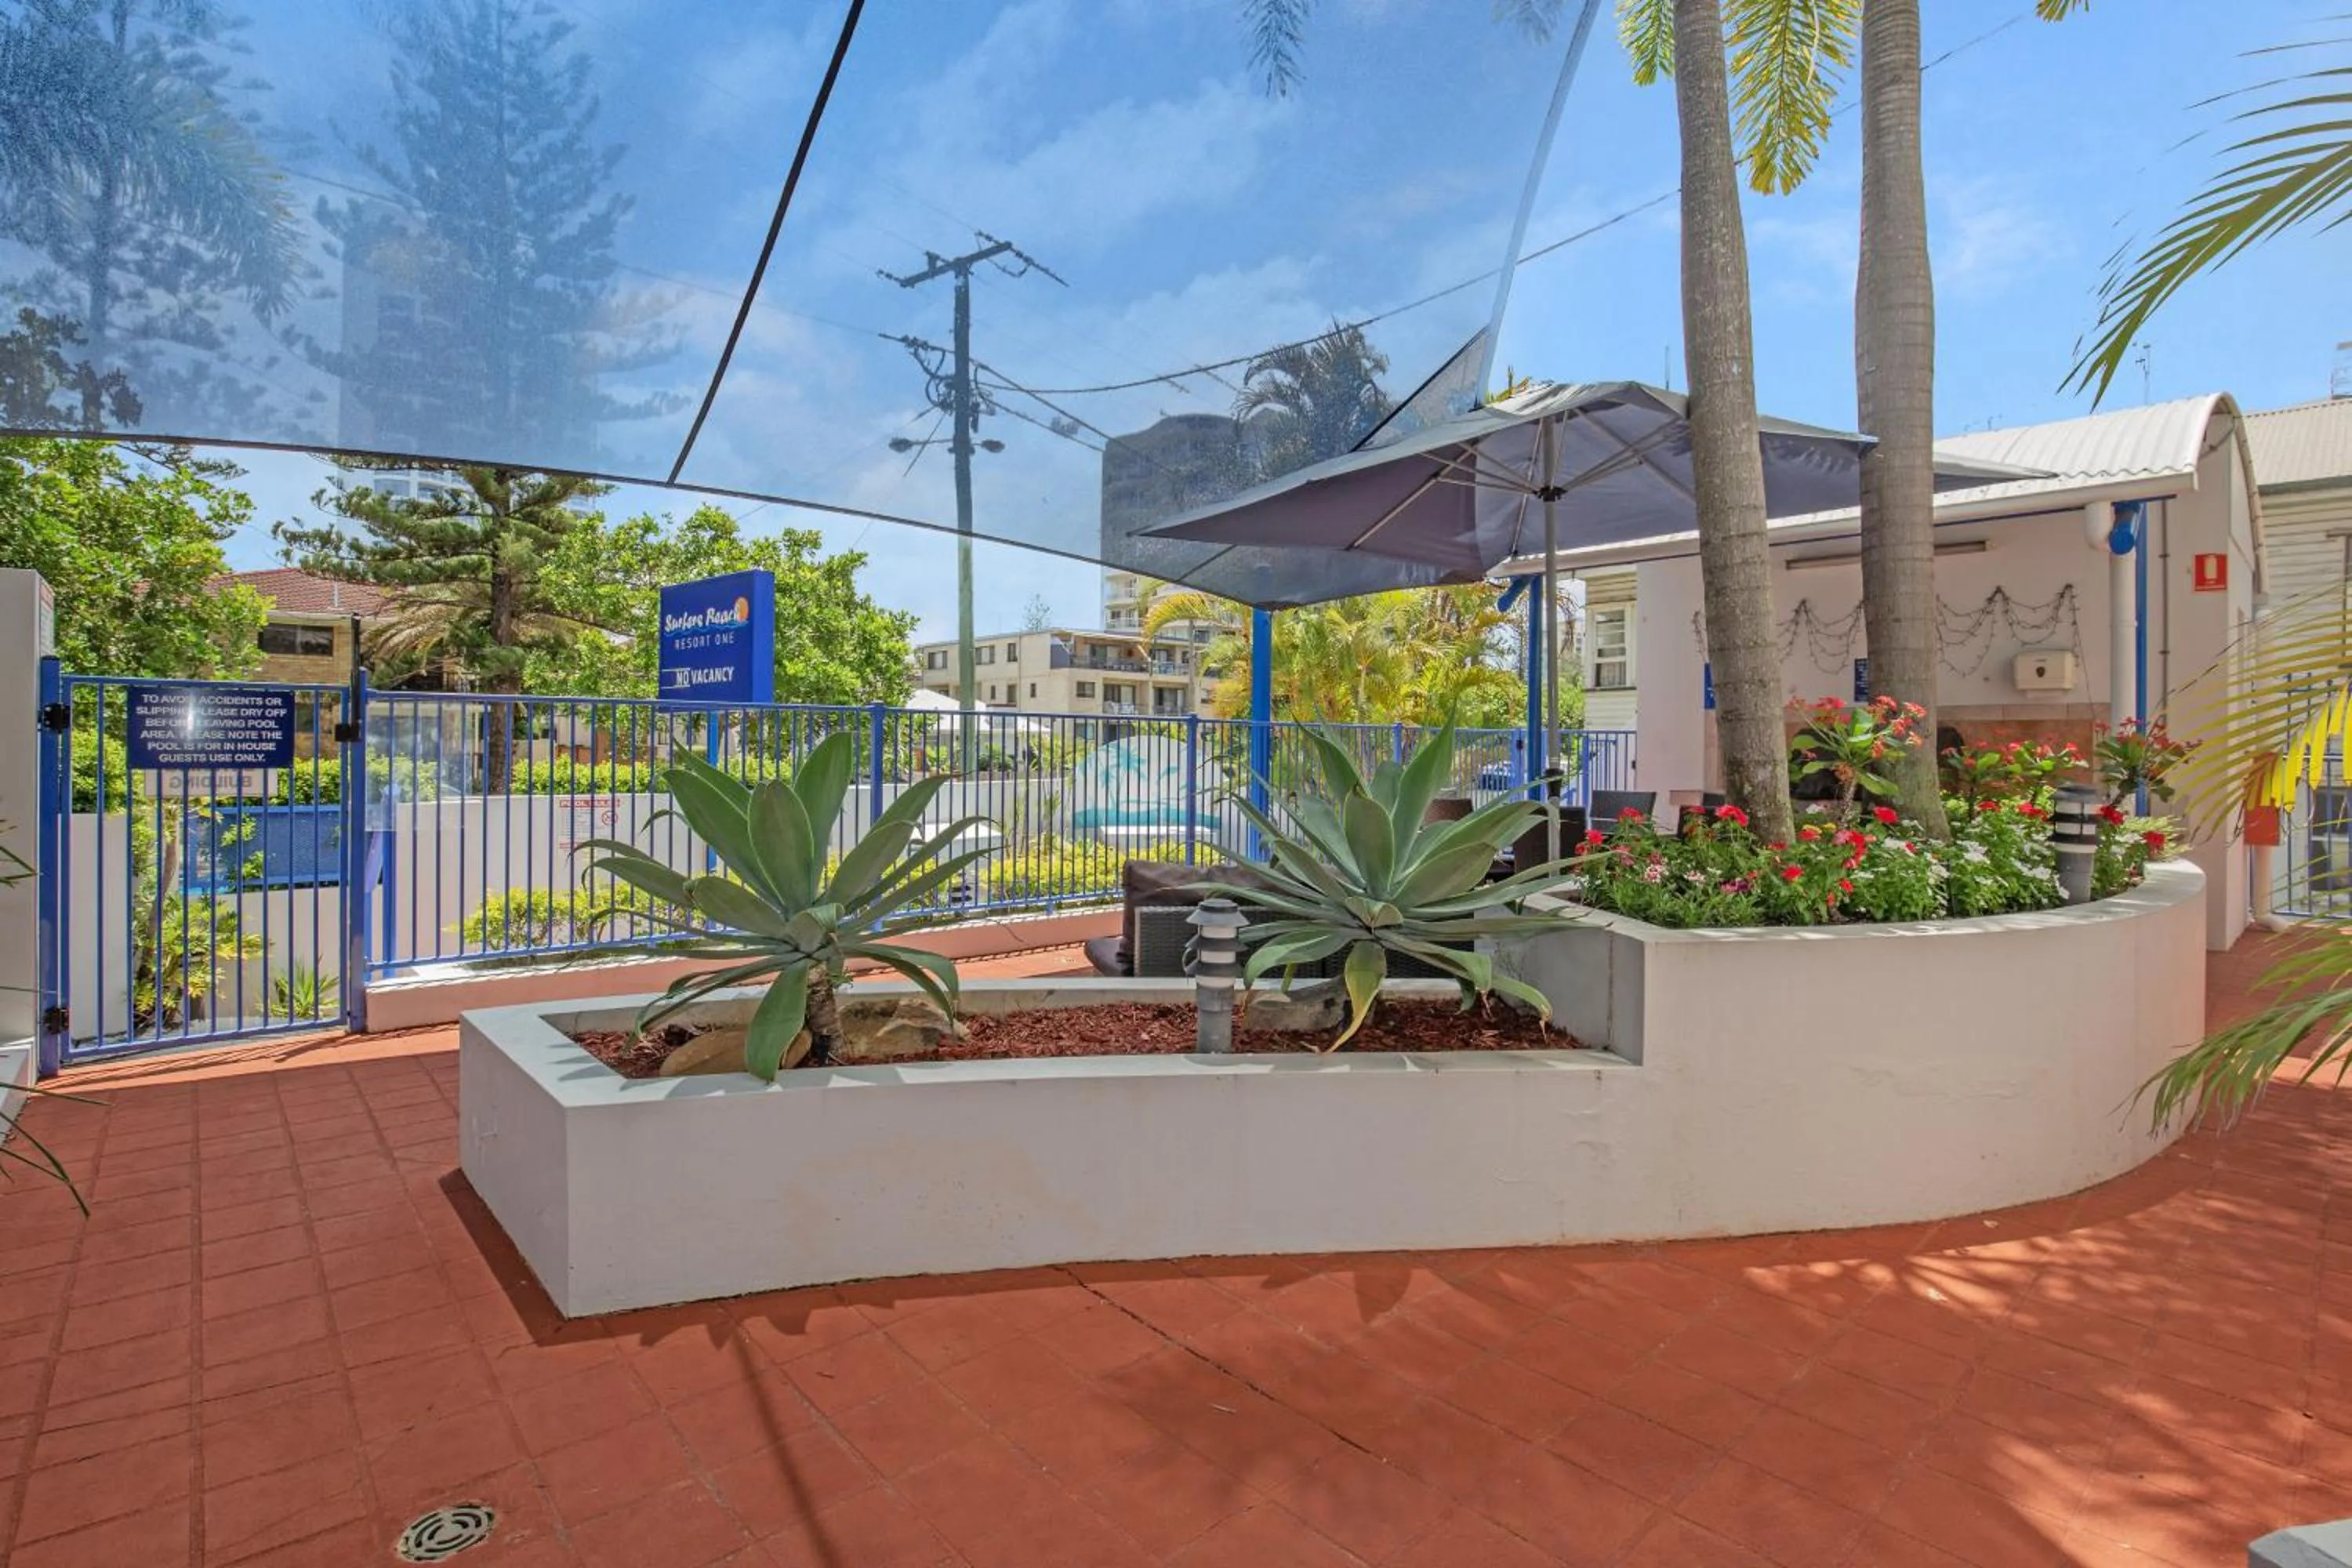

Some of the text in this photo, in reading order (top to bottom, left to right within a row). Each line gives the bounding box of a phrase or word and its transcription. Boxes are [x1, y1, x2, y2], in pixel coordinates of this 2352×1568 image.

[675, 631, 735, 650] RESORT ONE
[676, 666, 735, 686] NO VACANCY
[142, 694, 282, 706] TO AVO ACCIDENTS OR
[136, 706, 193, 716] SLIPPIN
[241, 708, 263, 717] DRY
[265, 708, 287, 718] OFF
[145, 717, 194, 728] BEFOR
[248, 719, 279, 728] POOL
[228, 730, 259, 739] NOTE
[260, 730, 282, 739] THE
[147, 742, 276, 750] POOL IS FOR IN HOUSE
[159, 753, 207, 763] GUESTS
[209, 753, 233, 763] USE
